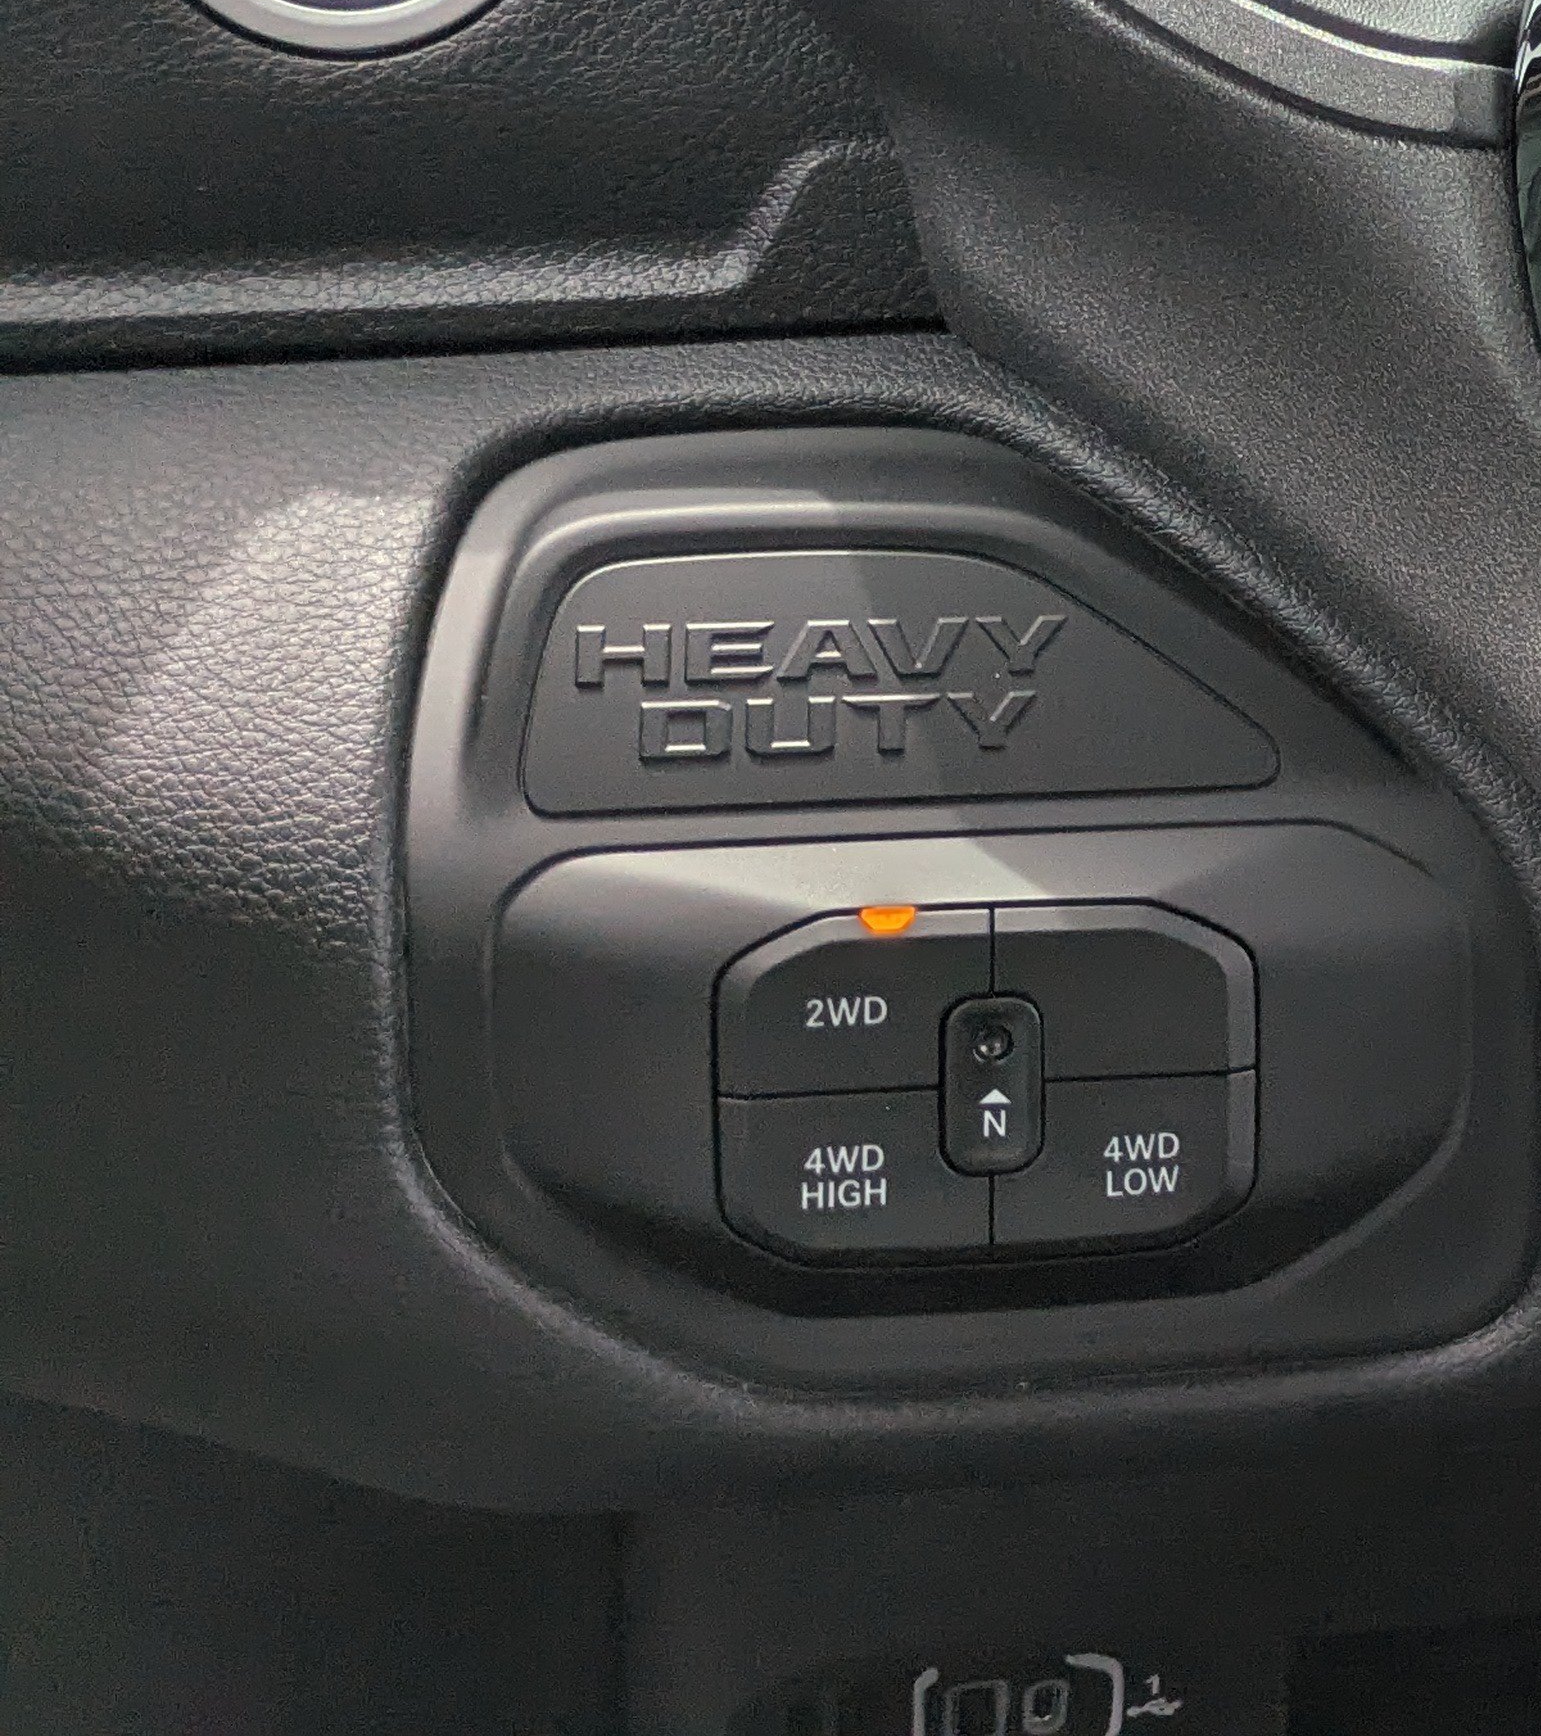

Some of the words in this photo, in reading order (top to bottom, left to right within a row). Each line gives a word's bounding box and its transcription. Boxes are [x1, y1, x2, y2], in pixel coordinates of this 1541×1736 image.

[575, 615, 1068, 689] HEAVY
[639, 690, 1036, 763] DUTY
[806, 995, 888, 1028] 2WD
[982, 1109, 1007, 1138] N
[804, 1144, 885, 1174] 4WD
[1104, 1132, 1180, 1162] 4WD
[801, 1176, 888, 1210] HIGH
[1105, 1165, 1179, 1198] LOW
